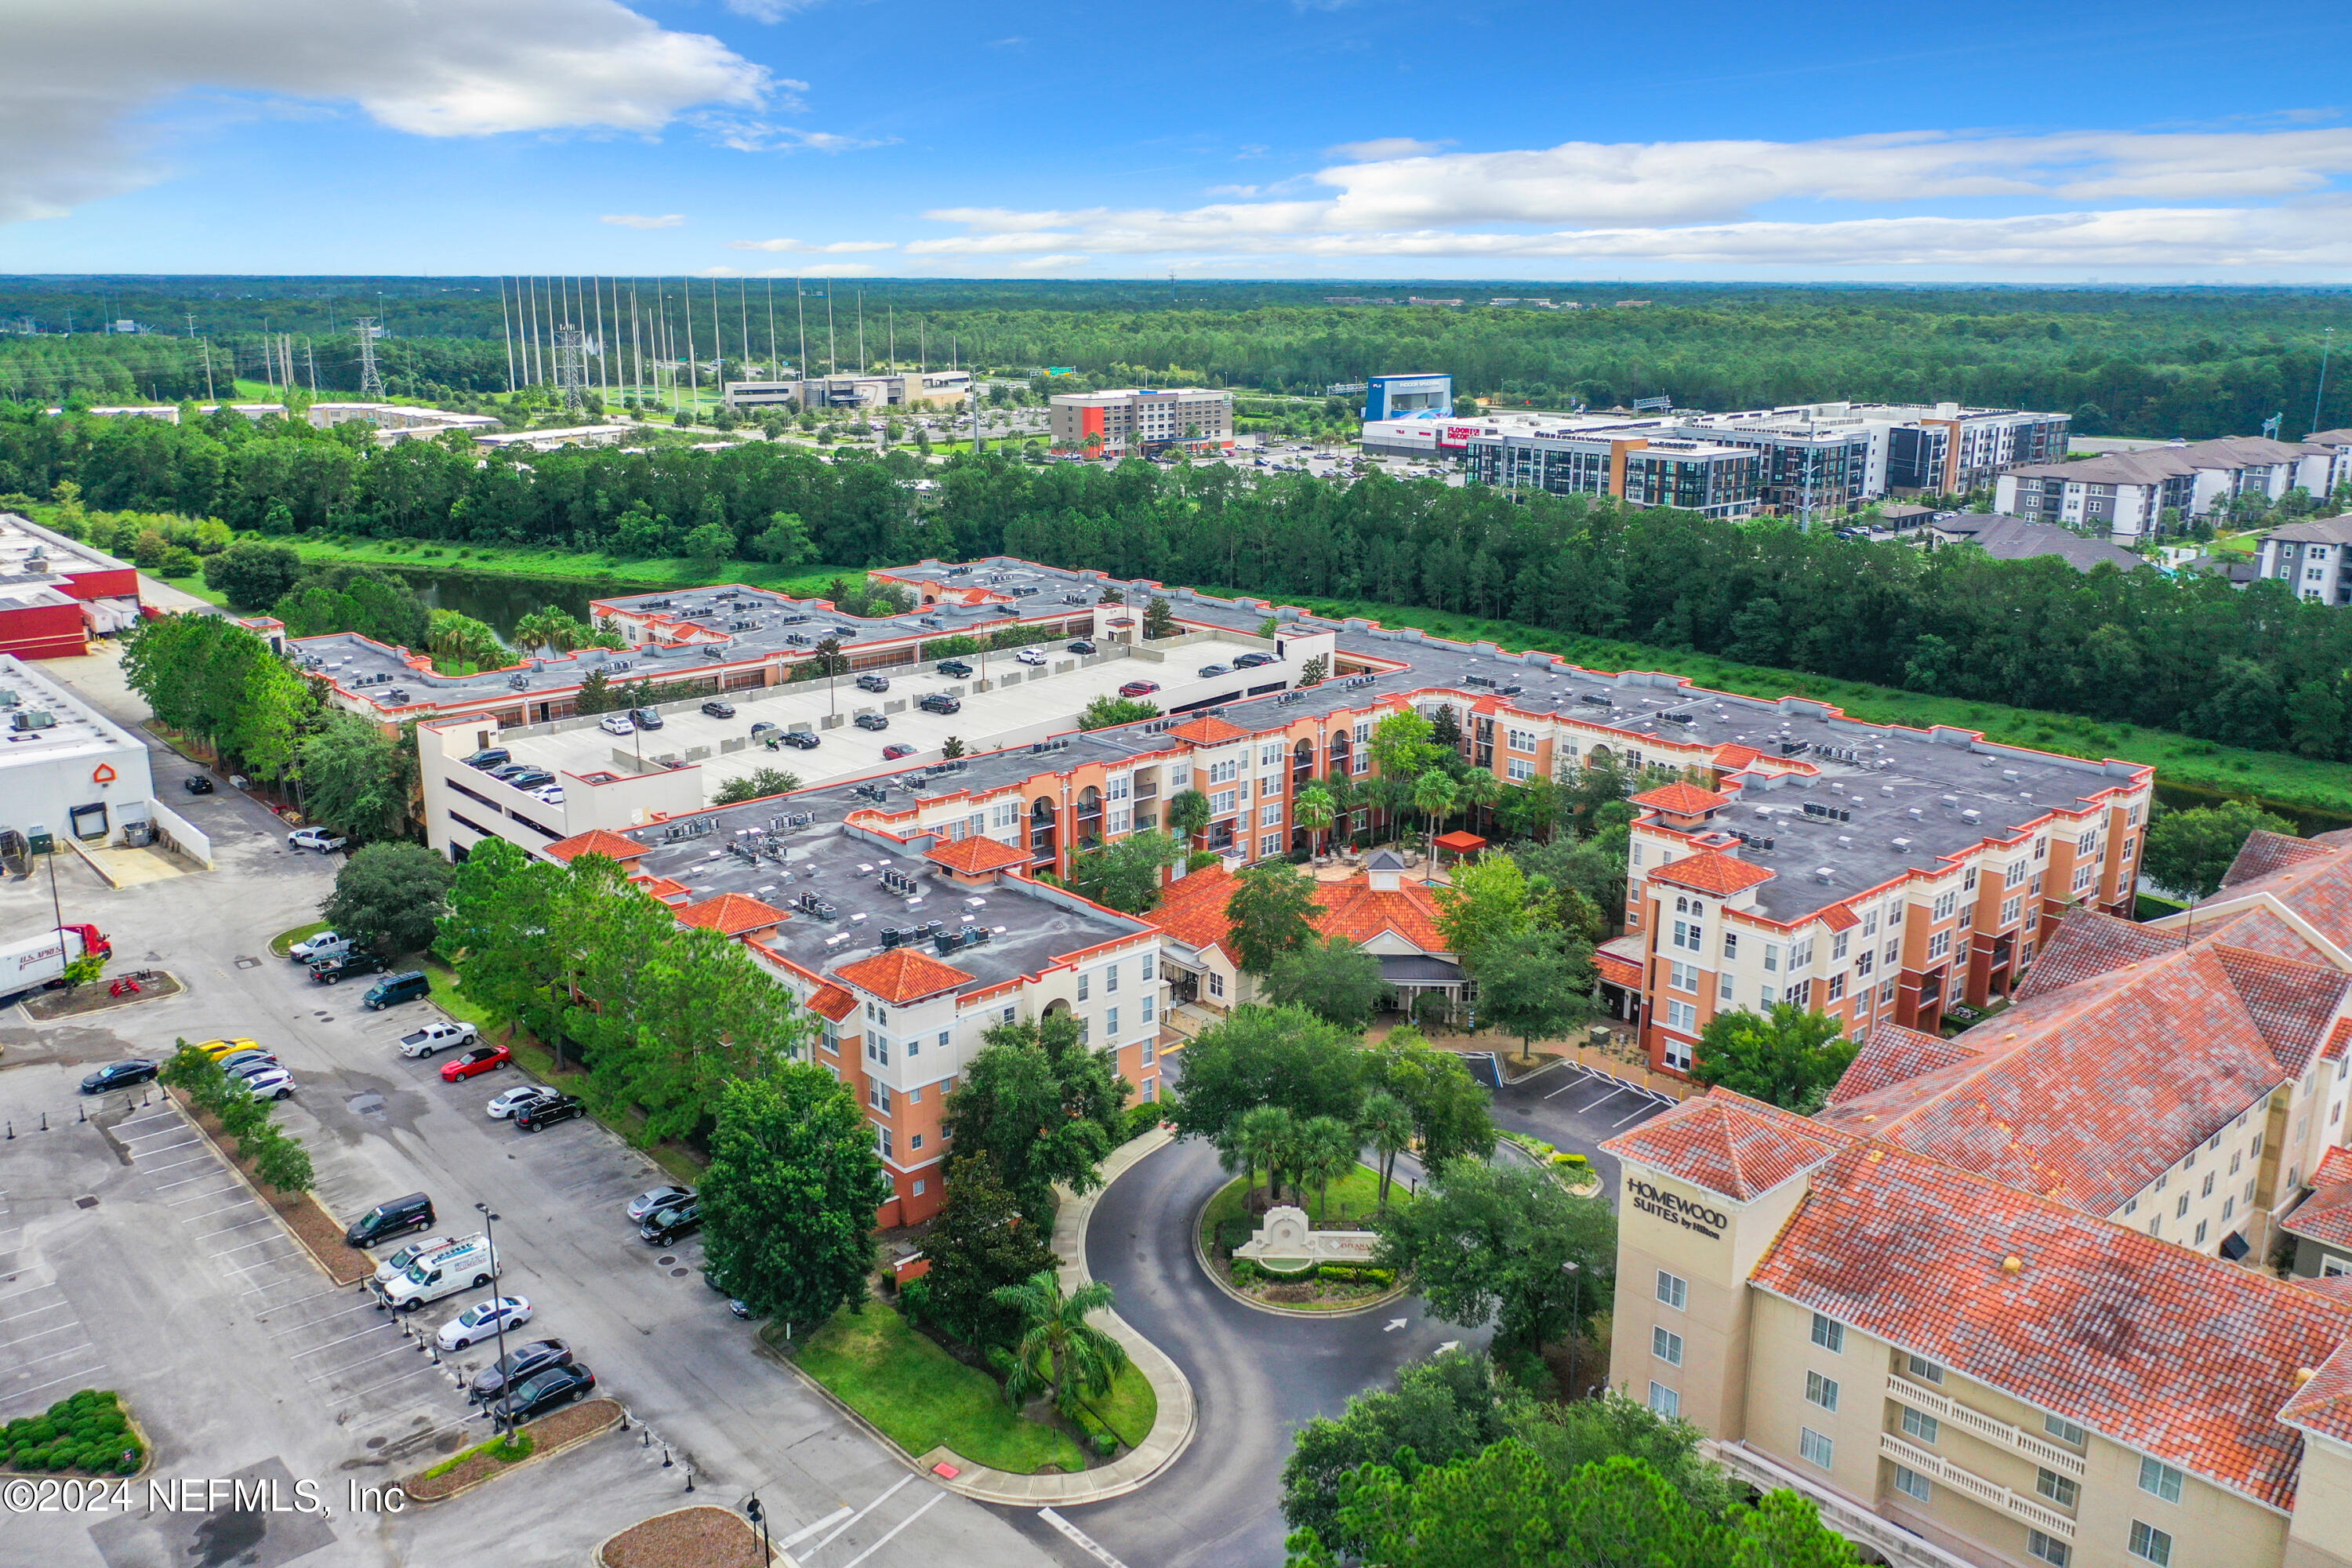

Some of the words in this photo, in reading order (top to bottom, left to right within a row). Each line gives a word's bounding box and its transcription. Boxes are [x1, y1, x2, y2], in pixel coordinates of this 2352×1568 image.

[1627, 1178, 1727, 1229] HOMEWOOD
[1633, 1196, 1679, 1224] SUITES
[1681, 1217, 1692, 1229] by
[1693, 1221, 1719, 1240] Hilton
